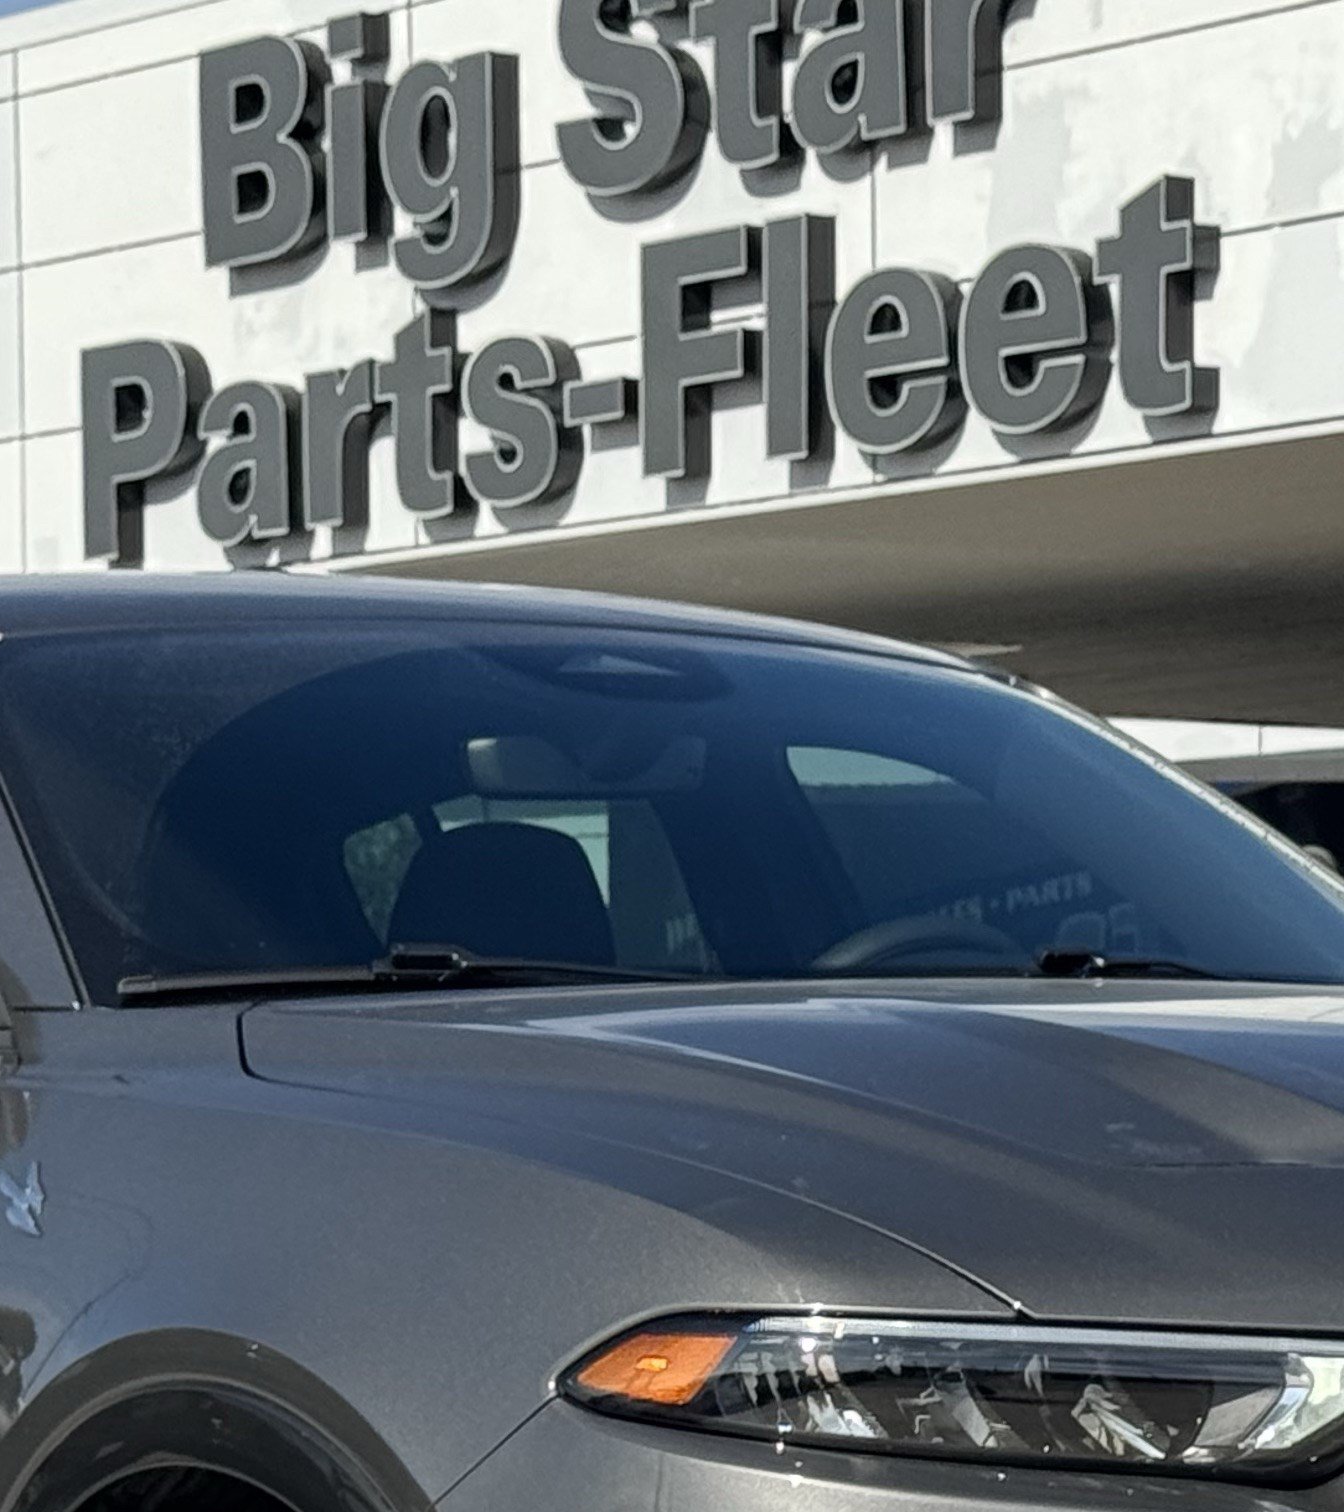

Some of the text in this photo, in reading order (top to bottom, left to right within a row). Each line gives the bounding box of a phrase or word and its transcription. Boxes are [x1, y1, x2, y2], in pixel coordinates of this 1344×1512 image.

[199, 0, 1002, 290] Big Star
[80, 175, 1196, 562] Parts-Fleet
